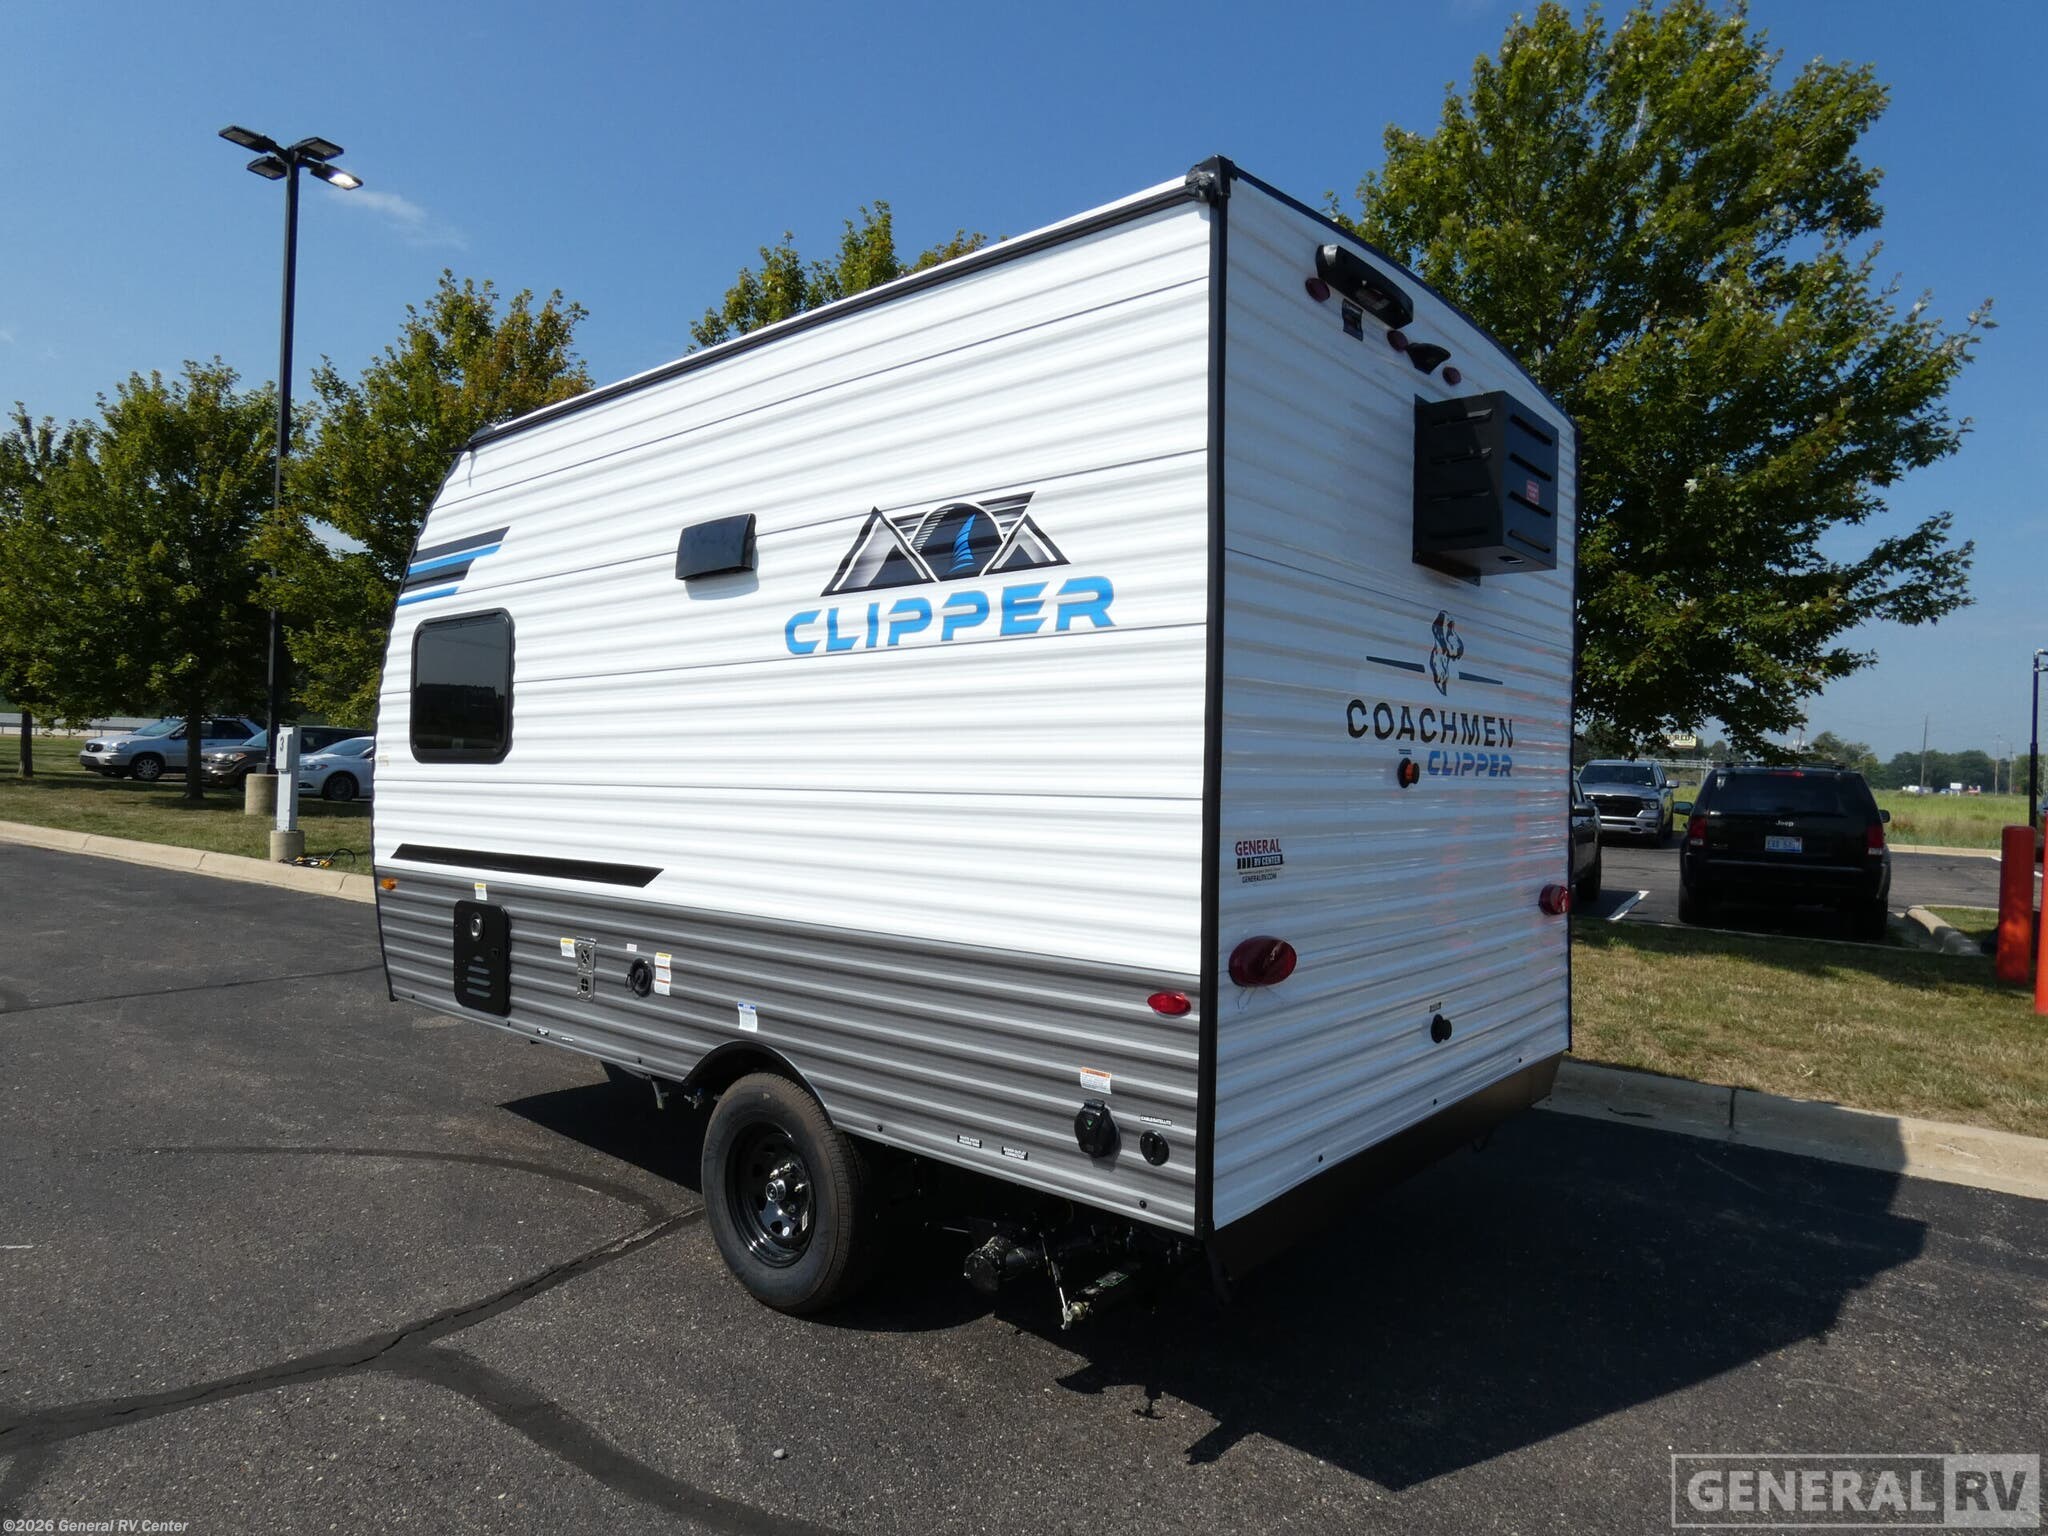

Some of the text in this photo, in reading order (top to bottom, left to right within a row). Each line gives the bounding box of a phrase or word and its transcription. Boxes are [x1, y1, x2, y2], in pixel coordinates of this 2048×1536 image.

[784, 575, 1116, 655] CLIPPER
[1346, 699, 1514, 748] COACHMEN
[279, 735, 285, 752] 3
[1427, 750, 1513, 777] CLIPPER
[1775, 820, 1794, 828] Jeep
[1235, 838, 1282, 856] GENERAL
[1253, 855, 1281, 866] RV CENTER
